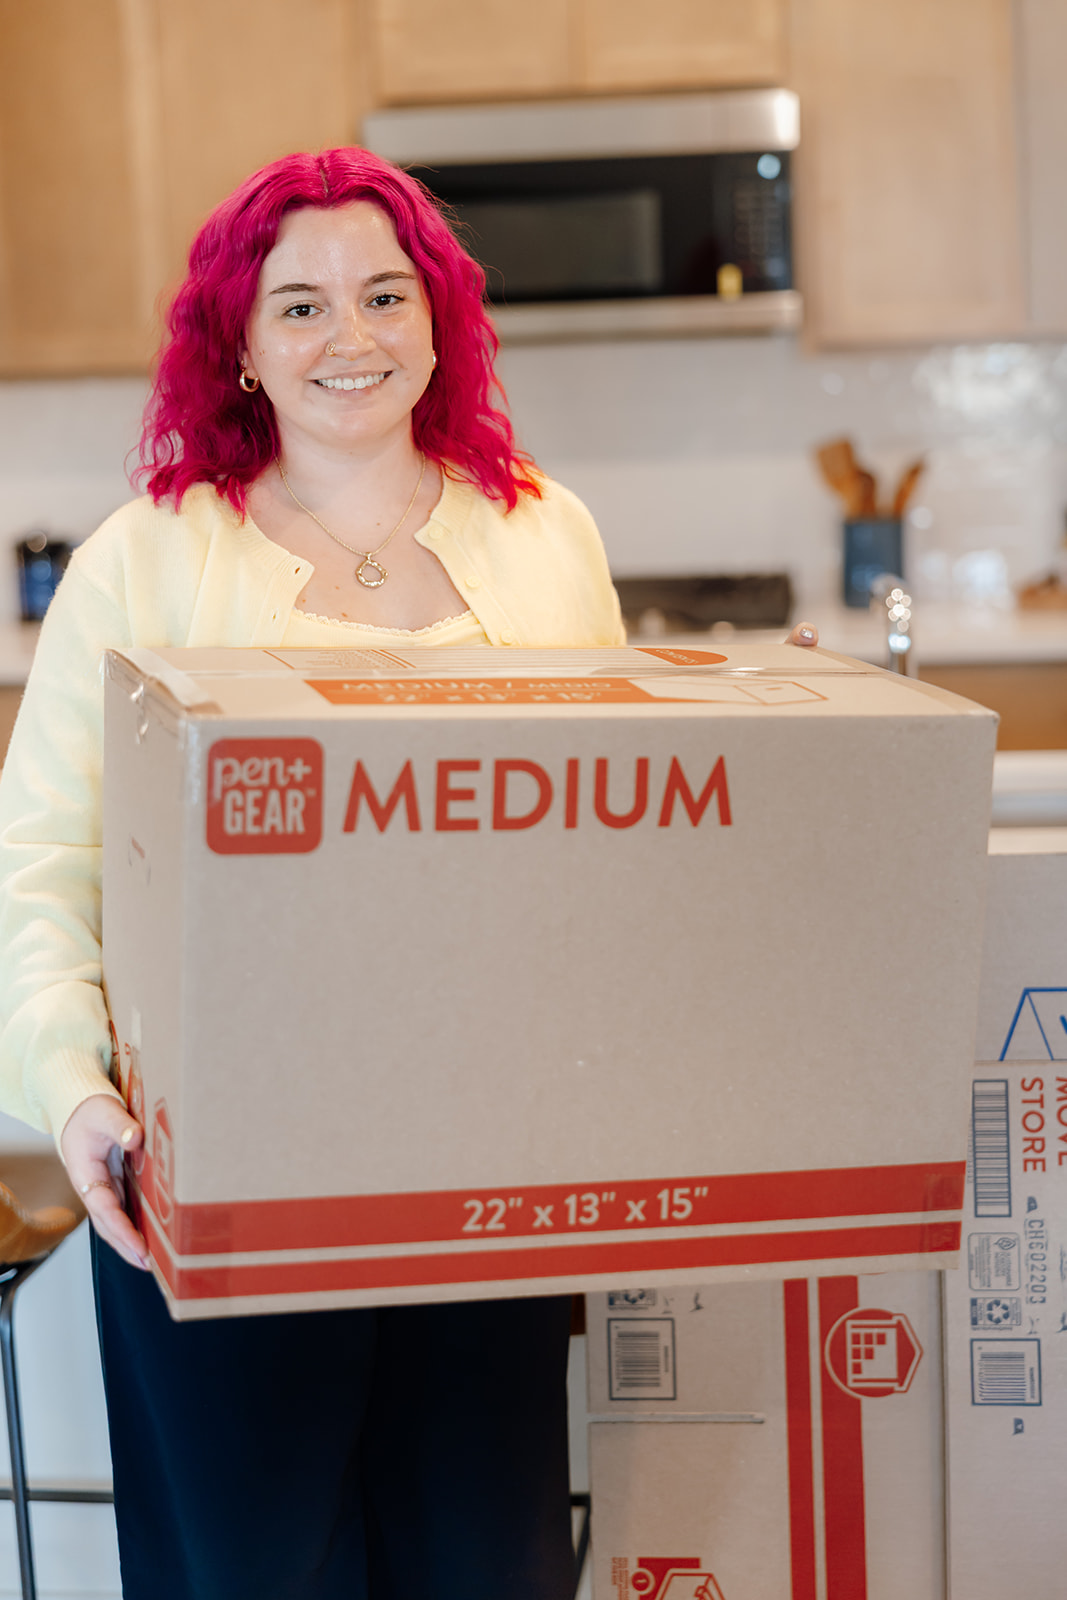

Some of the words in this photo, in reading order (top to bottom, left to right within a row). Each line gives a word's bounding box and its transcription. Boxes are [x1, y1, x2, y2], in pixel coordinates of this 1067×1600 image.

[342, 681, 494, 690] MEDIUM
[213, 757, 313, 802] pen+
[342, 754, 733, 834] MEDIUM
[224, 788, 306, 836] GEAR
[1021, 1077, 1046, 1173] STORE
[462, 1196, 524, 1232] 22"
[532, 1204, 554, 1228] x
[564, 1191, 616, 1226] 13"
[625, 1199, 648, 1222] x
[657, 1186, 709, 1220] 15"
